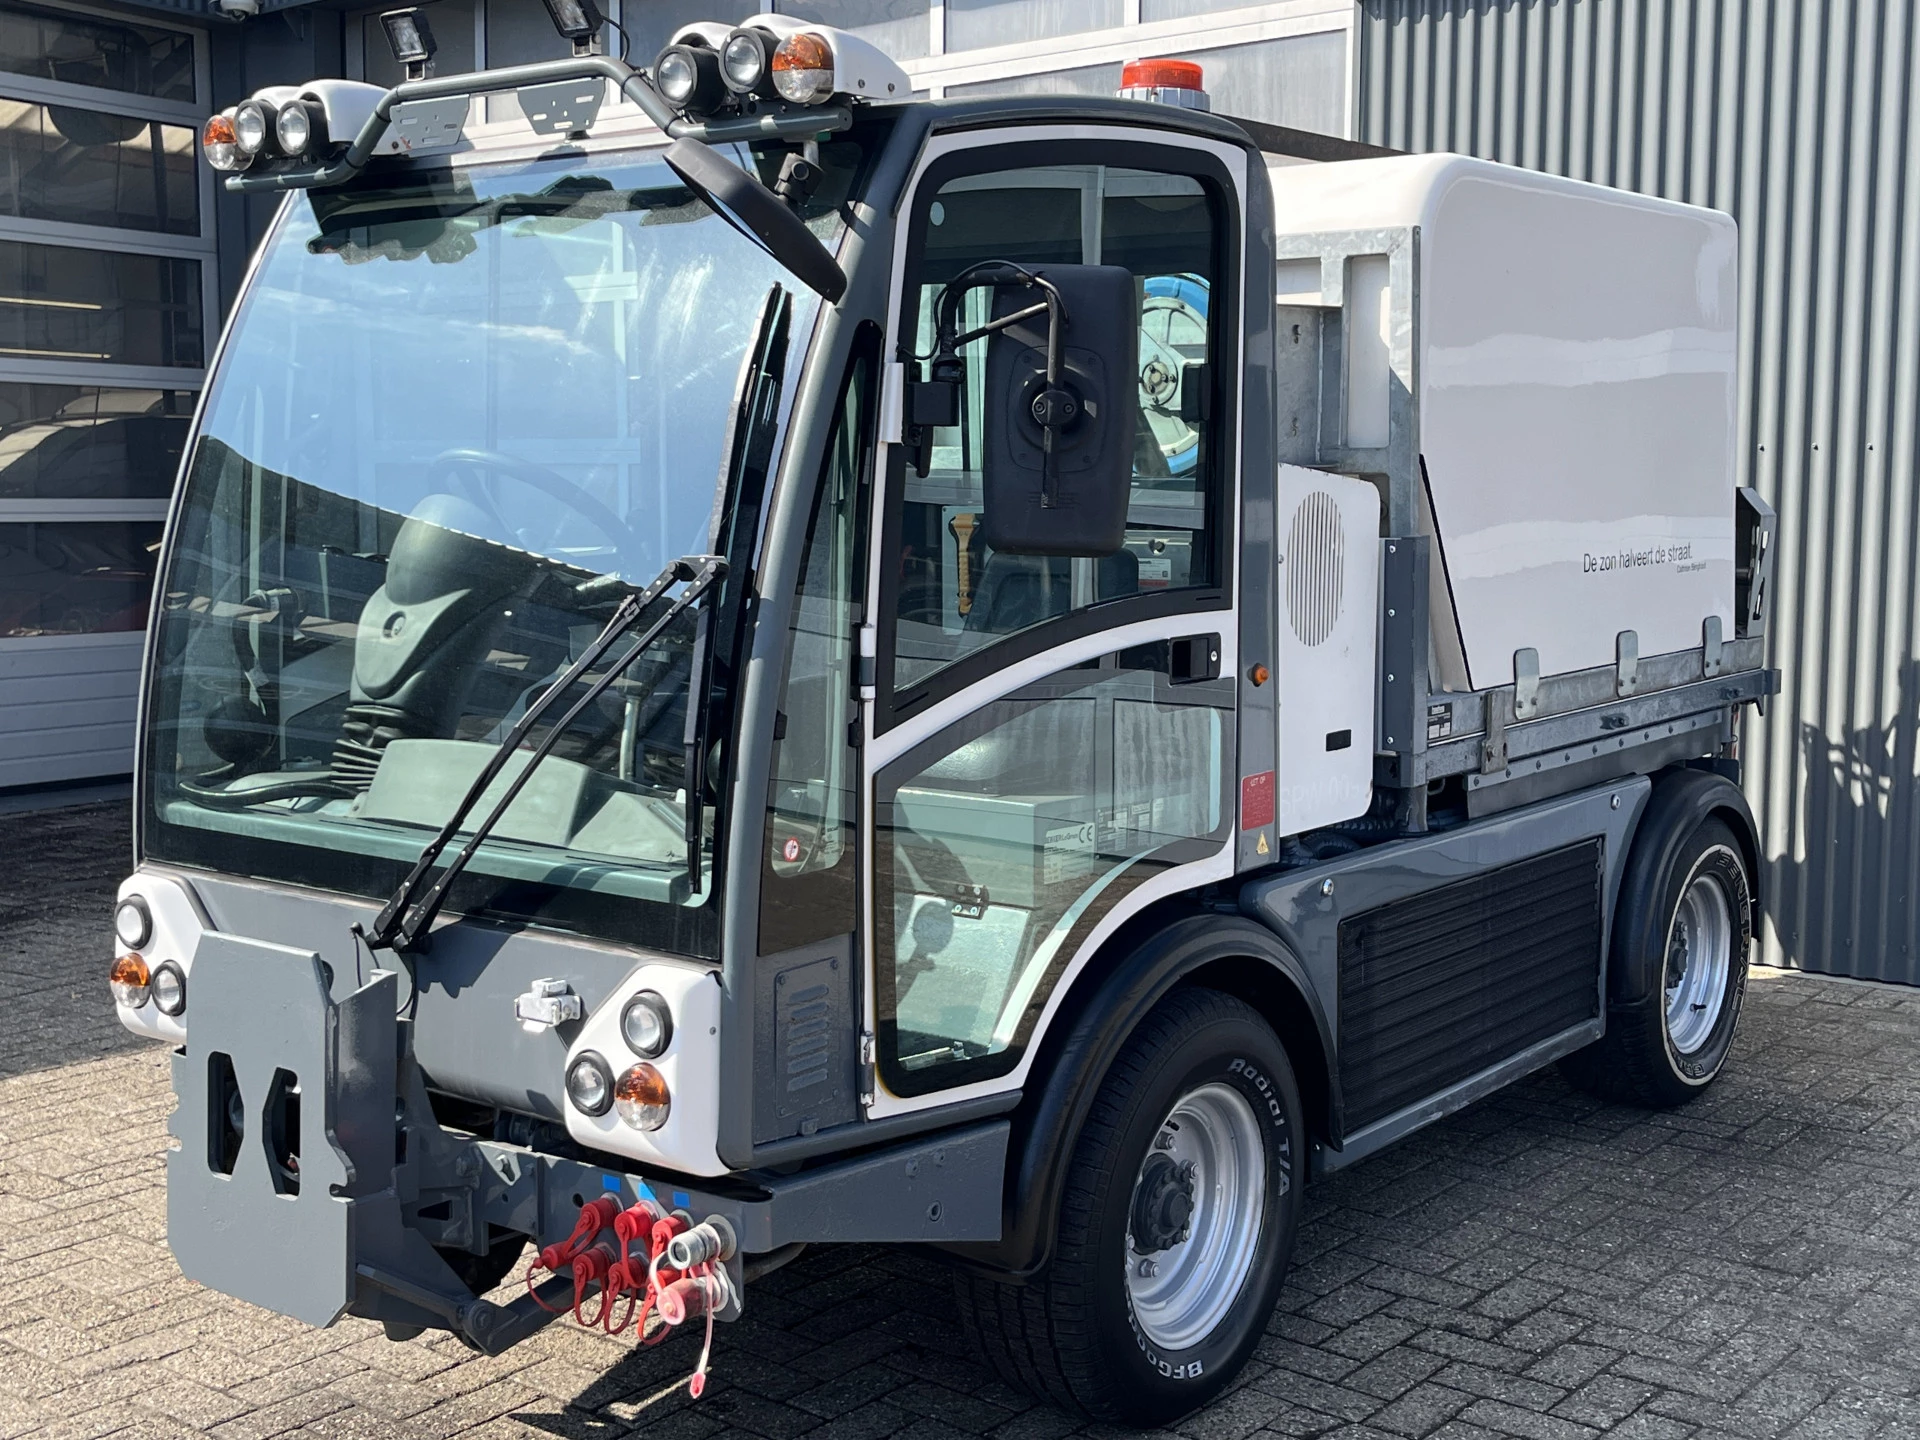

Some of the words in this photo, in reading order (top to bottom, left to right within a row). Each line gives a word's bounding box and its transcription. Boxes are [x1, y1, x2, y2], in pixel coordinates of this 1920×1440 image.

[1583, 553, 1597, 573] De
[1599, 555, 1617, 571] zon
[1619, 547, 1654, 569] halveert
[1655, 544, 1666, 564] de
[1277, 1137, 1292, 1197] T/A
